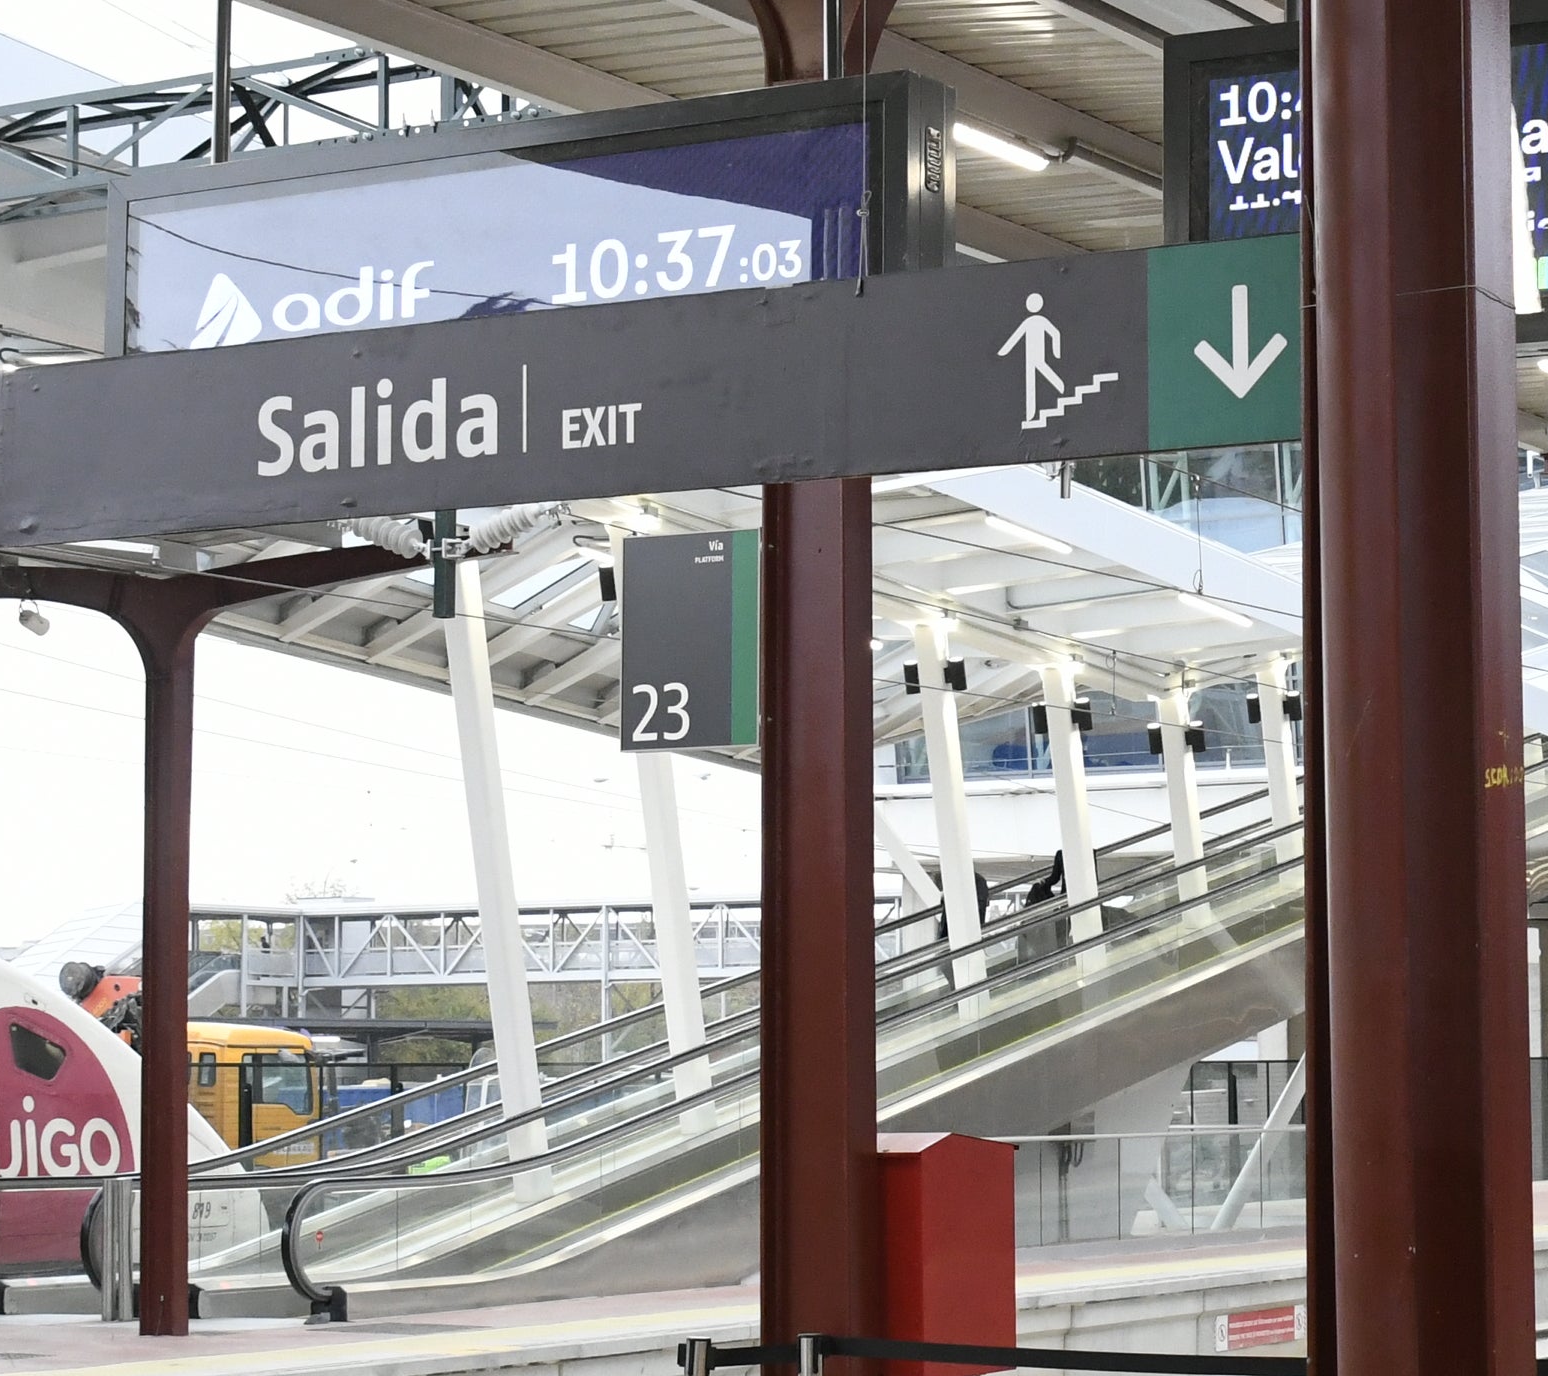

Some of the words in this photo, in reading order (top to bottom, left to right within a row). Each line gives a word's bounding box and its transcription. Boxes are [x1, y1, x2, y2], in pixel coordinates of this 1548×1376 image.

[1220, 81, 1301, 127] 10:
[1217, 133, 1301, 184] Val
[272, 260, 435, 332] adif
[256, 377, 499, 476] Salida
[562, 402, 642, 450] EXIT
[694, 555, 725, 564] PLATFORM
[708, 539, 724, 551] Vía
[631, 682, 690, 742] 23
